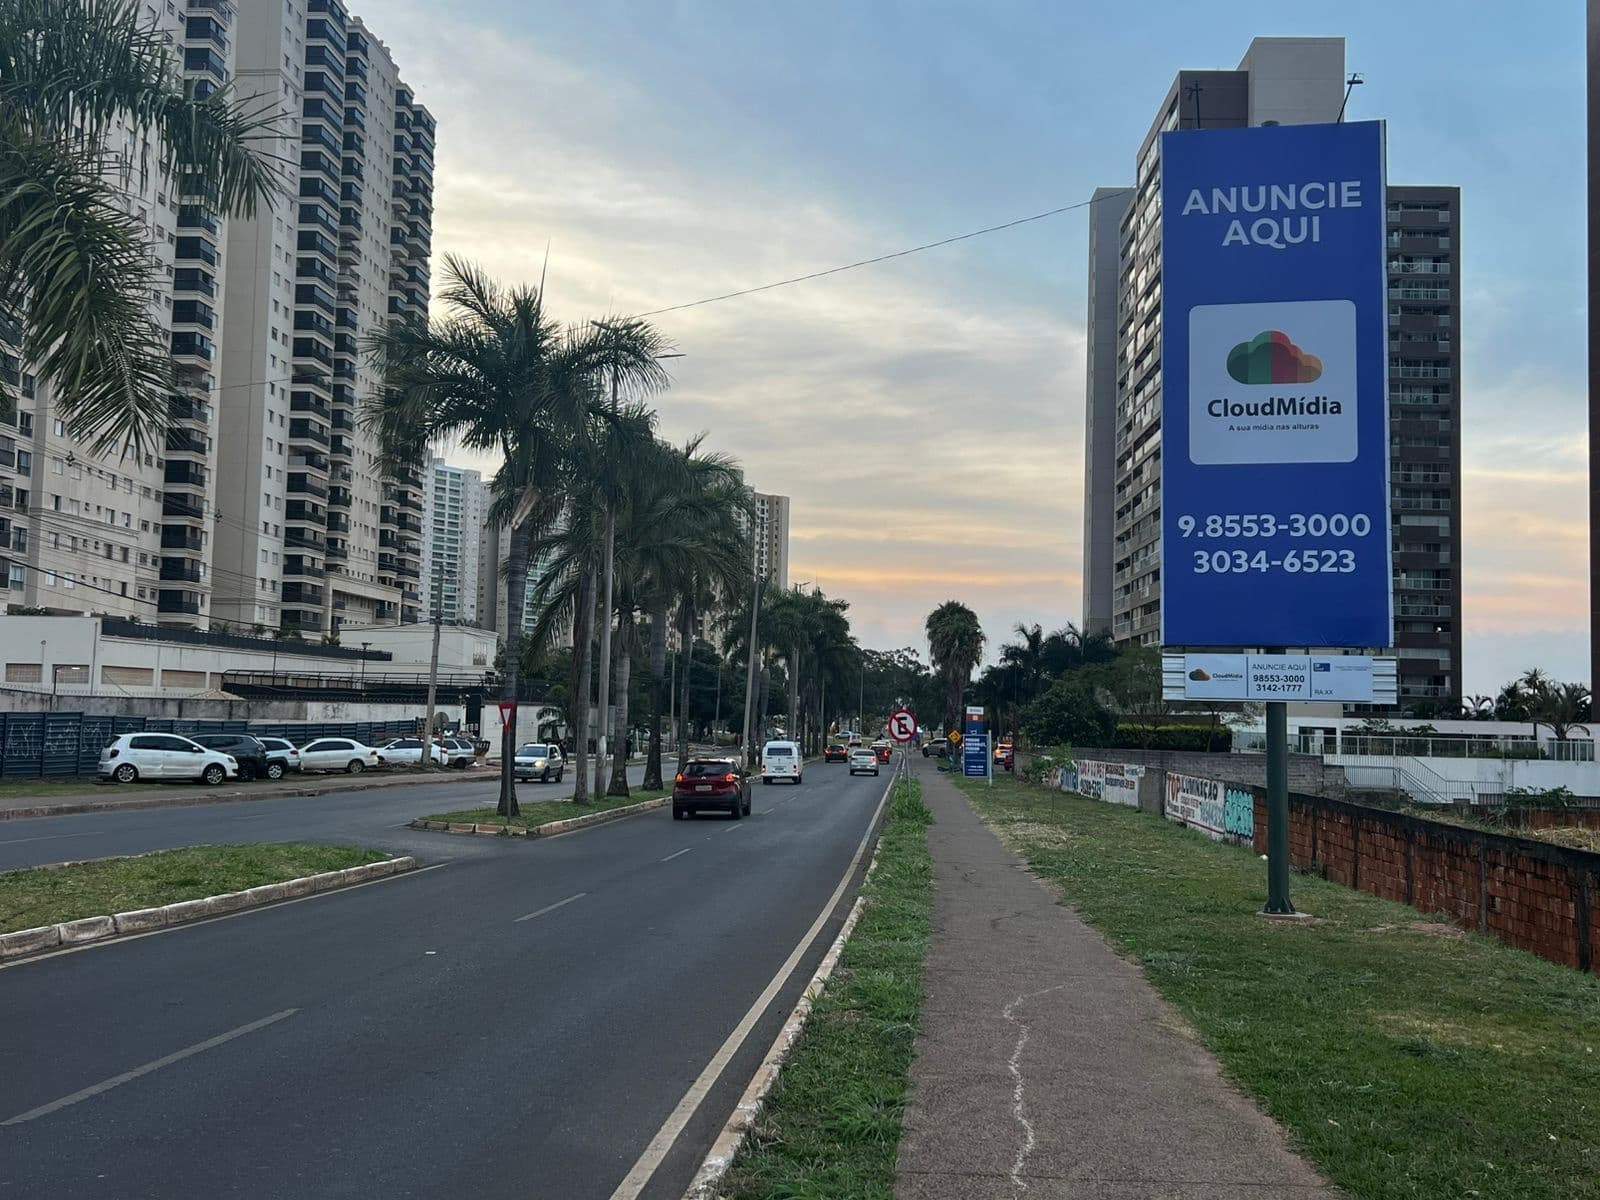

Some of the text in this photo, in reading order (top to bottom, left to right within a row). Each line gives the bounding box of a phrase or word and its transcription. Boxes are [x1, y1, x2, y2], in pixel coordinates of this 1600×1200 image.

[1181, 181, 1362, 216] ANUNCIE
[1221, 215, 1320, 249] AQUI
[1207, 396, 1342, 418] CloudMídia
[1177, 513, 1371, 538] 9.8553-3000
[1193, 549, 1356, 573] 3034-6523
[1252, 663, 1286, 671] ANUNCIE
[1253, 674, 1305, 683] 98553-3000
[1256, 683, 1302, 692] 3142-1777
